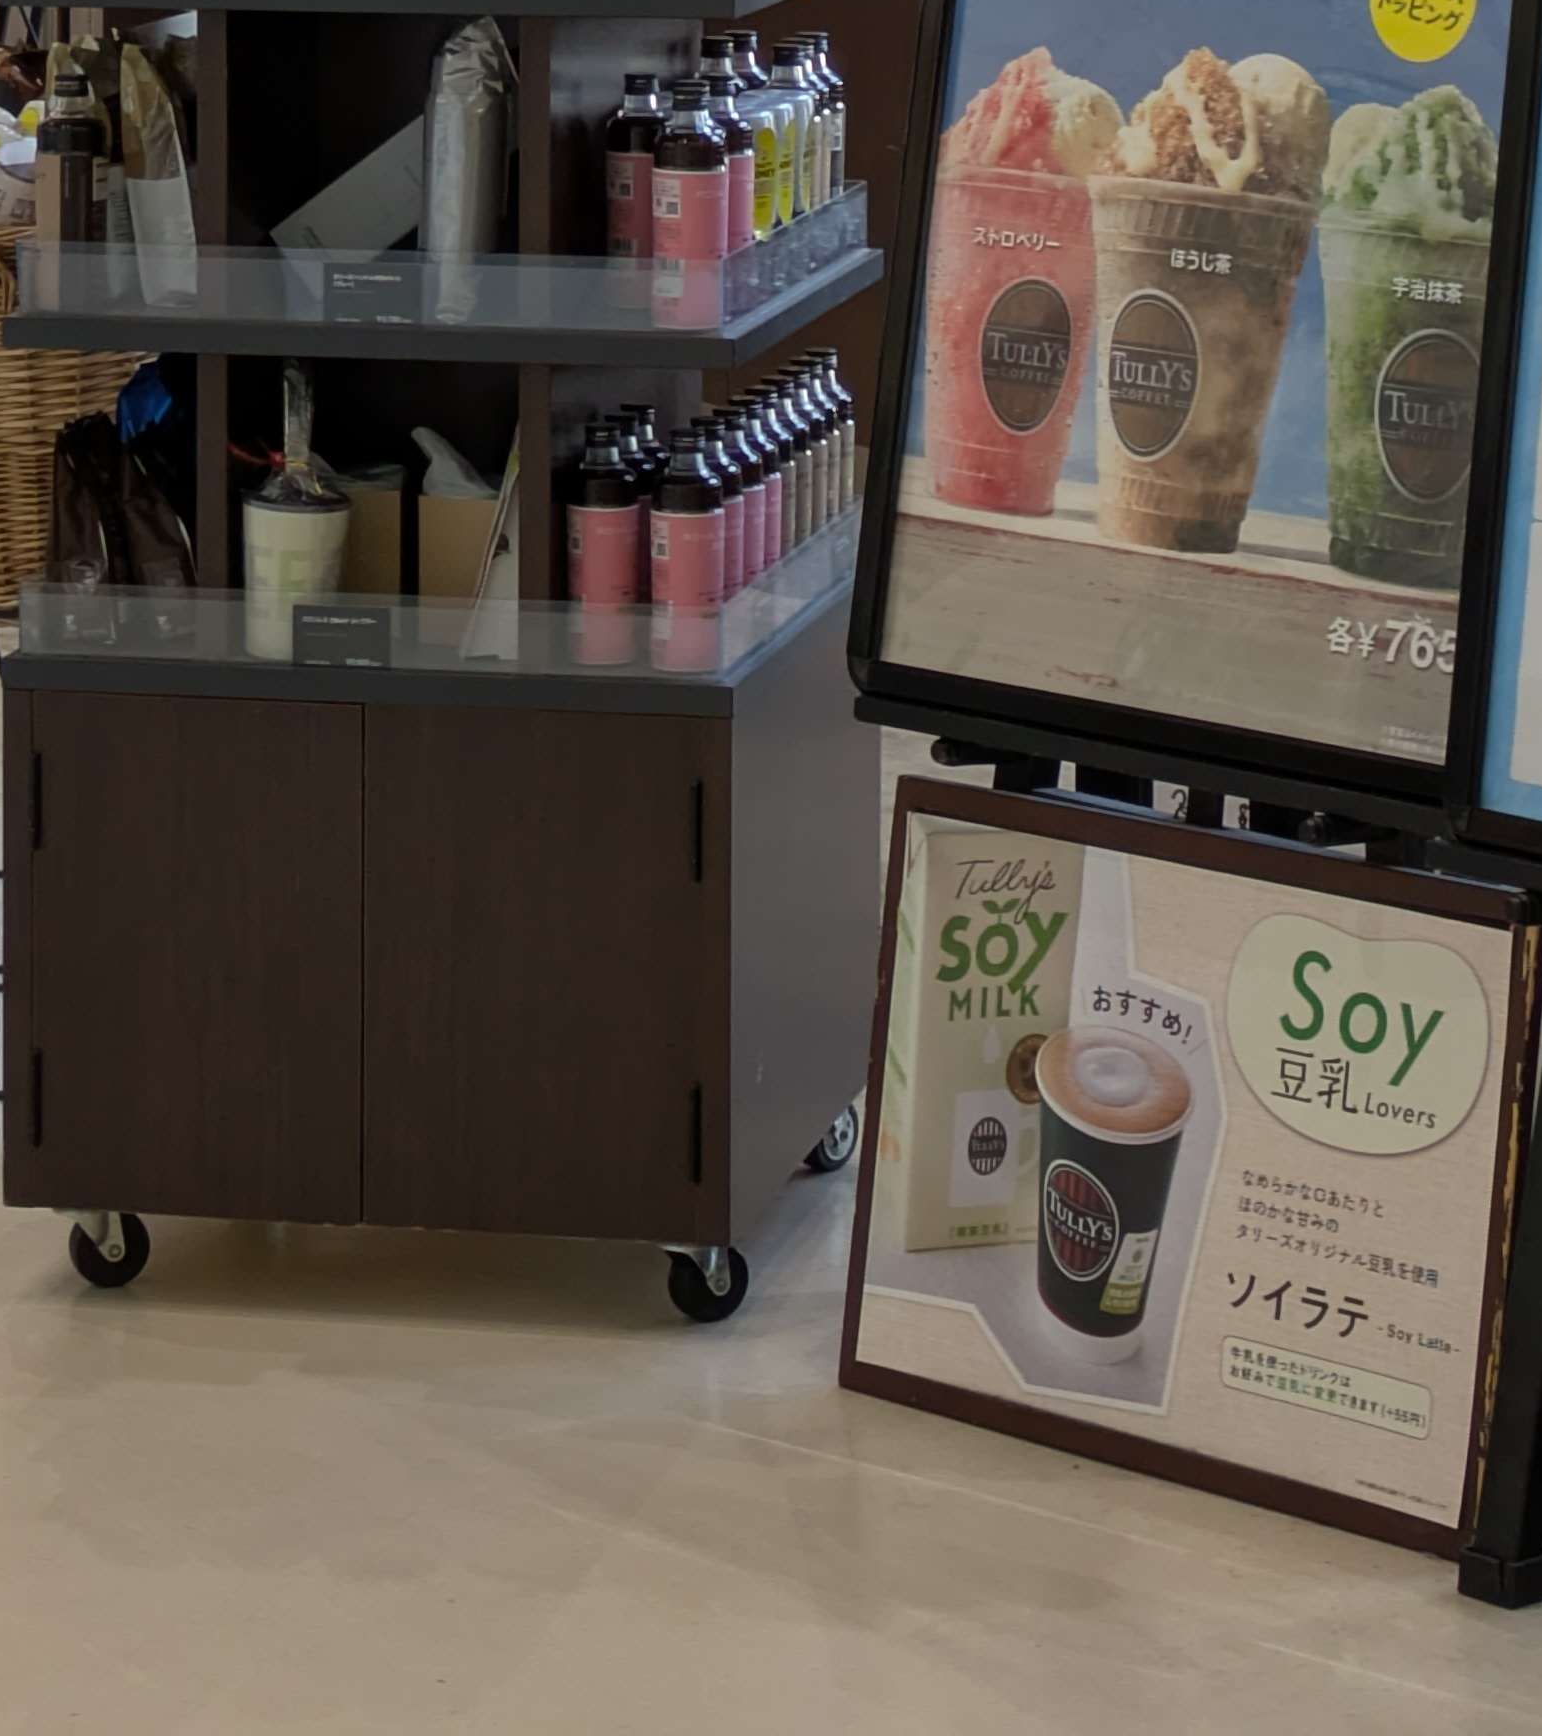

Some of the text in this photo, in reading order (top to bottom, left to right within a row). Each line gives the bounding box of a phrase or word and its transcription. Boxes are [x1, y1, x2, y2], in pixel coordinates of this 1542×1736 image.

[971, 226, 1062, 252] ストロベリー
[1170, 248, 1234, 275] ほうじ茶
[1391, 277, 1464, 304] 宇治抹茶
[987, 332, 1067, 369] TULLY'S
[1111, 351, 1192, 391] TULLY'S
[955, 857, 1058, 922] Tully's
[948, 984, 1041, 1022] MILK
[1091, 984, 1194, 1045] おすすめ!
[1278, 950, 1446, 1087] Soy
[1271, 1047, 1438, 1130] 豆乳 Lovers
[1047, 1187, 1113, 1241] TULLY'S
[1238, 1196, 1339, 1233] ほのかな甘みの
[1242, 1170, 1384, 1218] なめらかな口あたりと
[1236, 1224, 1439, 1288] タリーズオリジナル豆乳を使用
[1228, 1272, 1369, 1338] ソイラテ
[1230, 1346, 1351, 1388] 牛乳を使ったドリンクは
